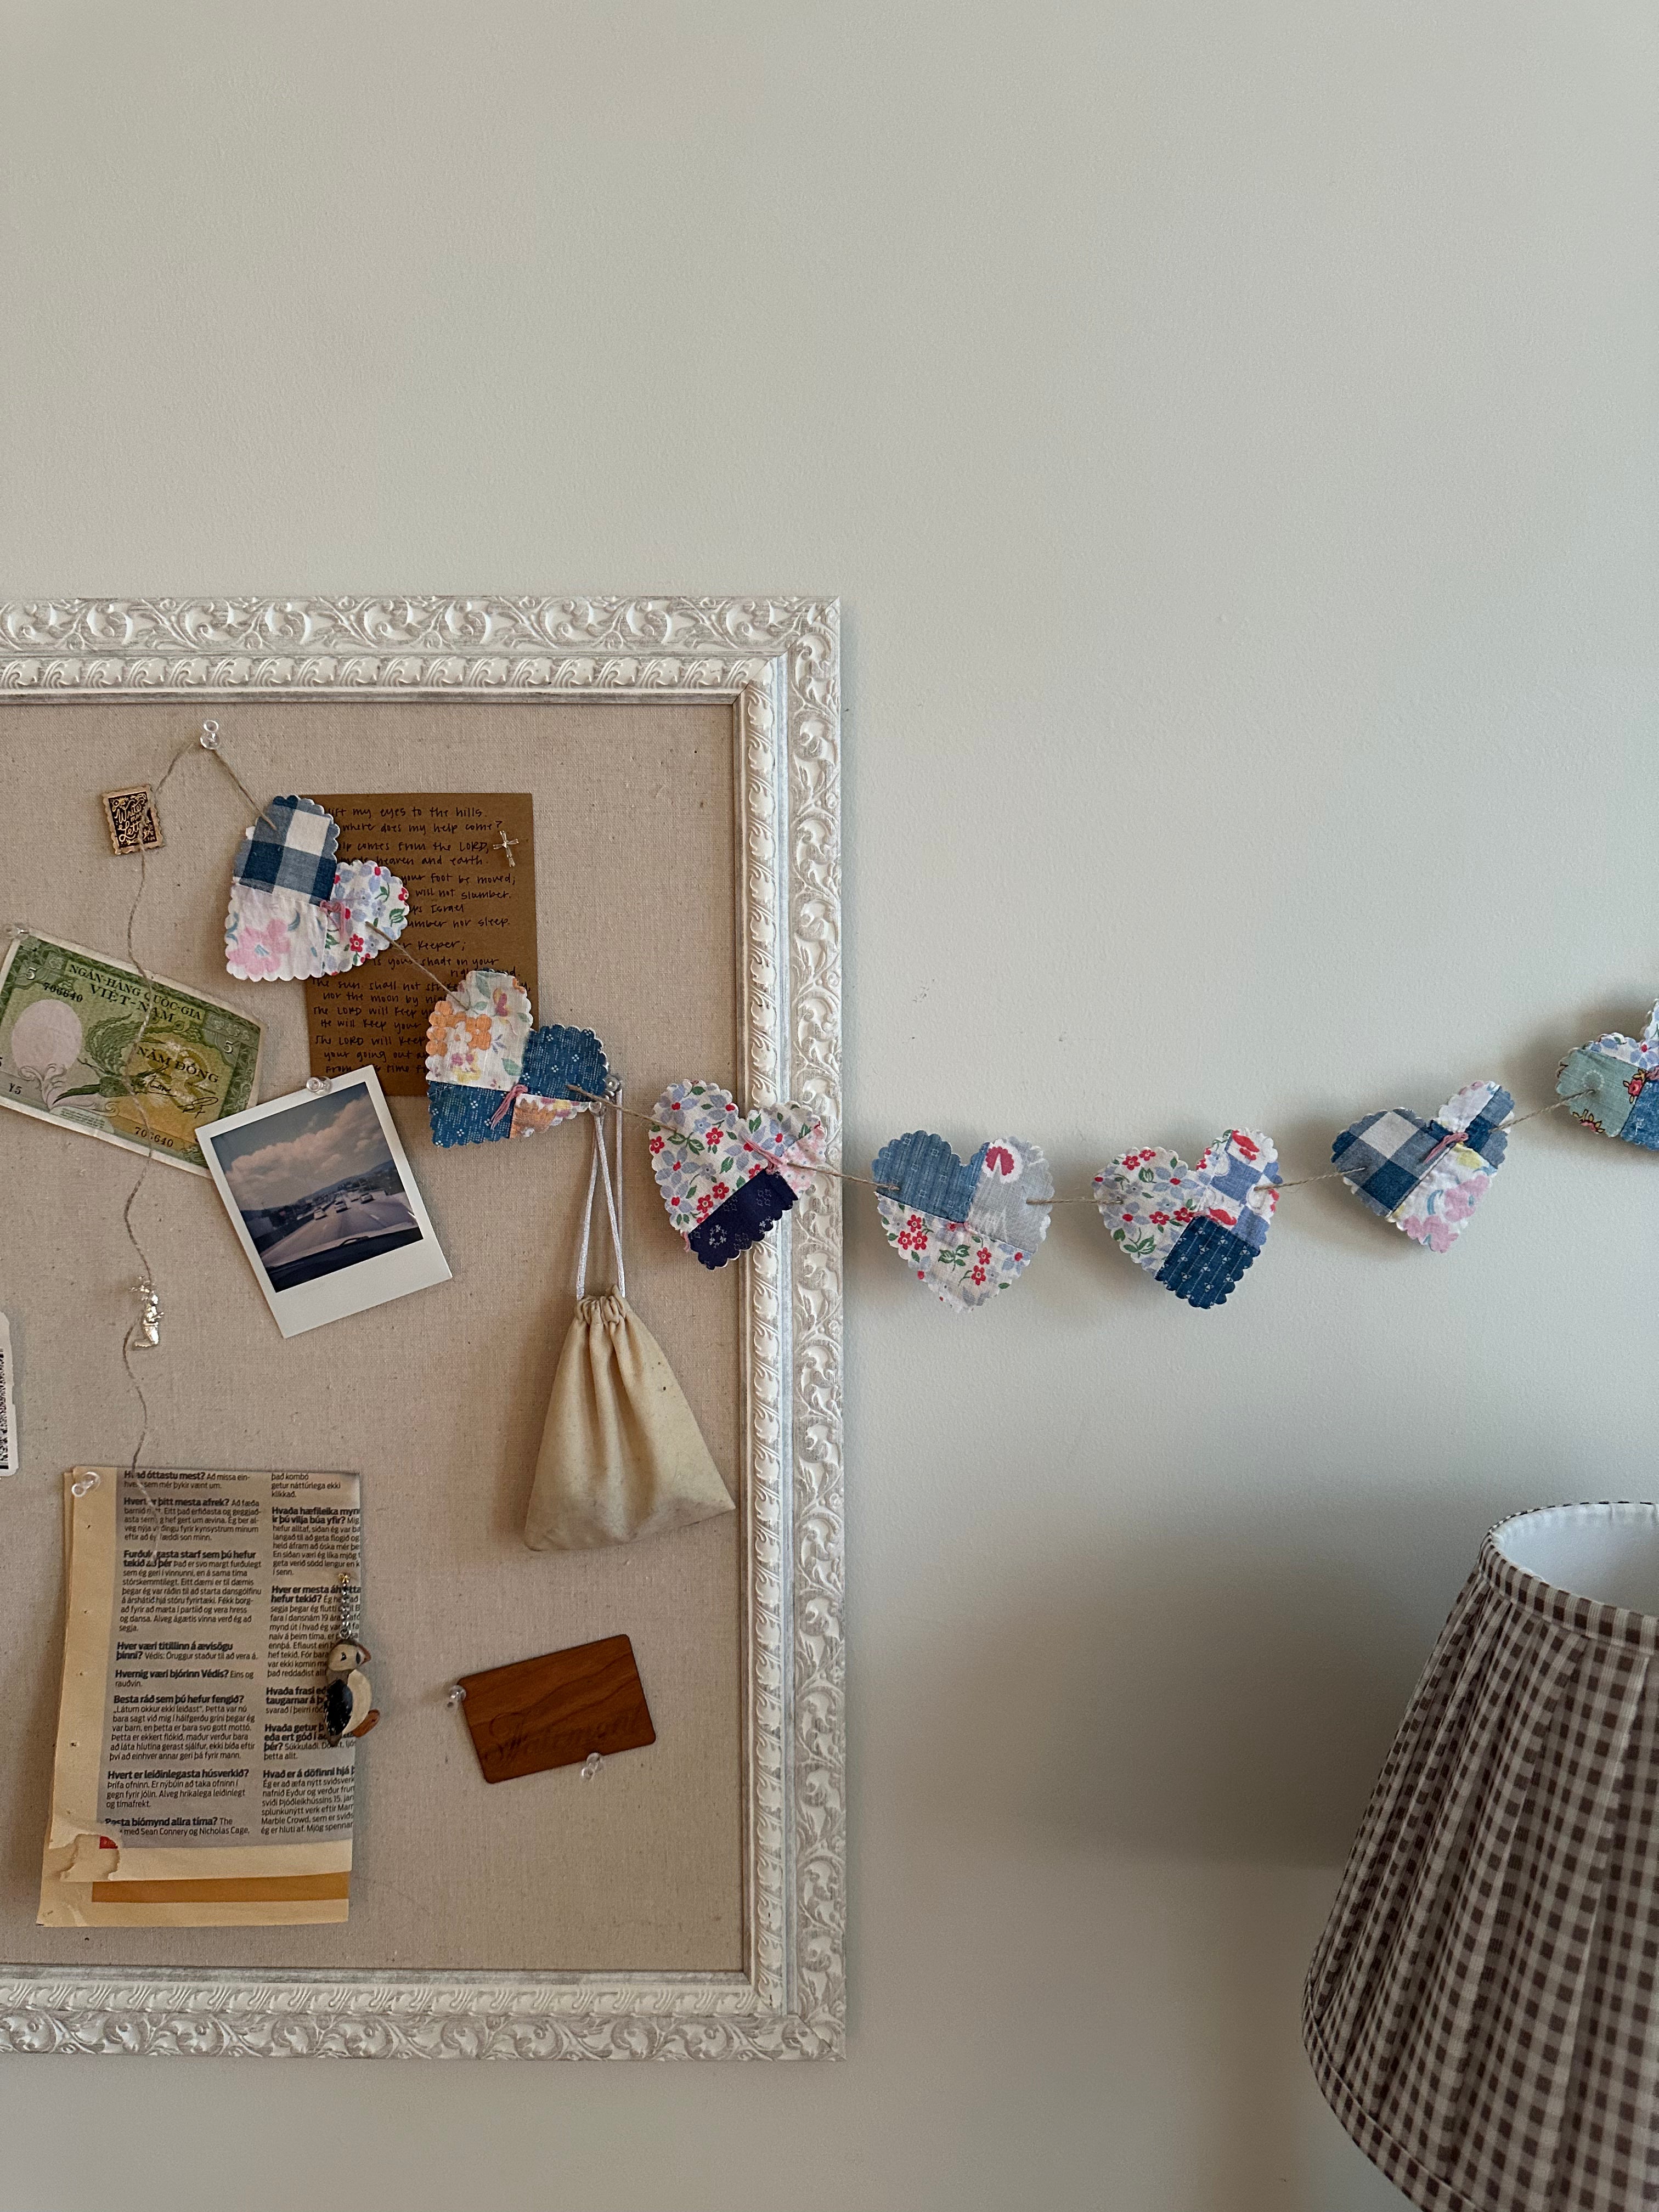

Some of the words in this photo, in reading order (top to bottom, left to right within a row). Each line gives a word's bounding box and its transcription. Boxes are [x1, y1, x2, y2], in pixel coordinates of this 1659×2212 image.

[353, 808, 371, 819] my
[380, 808, 405, 819] eyes
[412, 807, 422, 817] to
[430, 806, 448, 817] the
[456, 807, 487, 817] hills.
[381, 823, 401, 833] does
[409, 824, 426, 835] my
[434, 823, 458, 834] help
[358, 843, 390, 851] comes
[433, 842, 451, 851] the
[460, 842, 489, 854] LORD,
[376, 856, 414, 865] heaven
[422, 855, 442, 865] and
[450, 855, 489, 866] earth.
[431, 873, 453, 883] foot
[459, 875, 470, 884] be
[477, 873, 515, 885] moved;
[416, 888, 434, 896] will
[439, 888, 456, 897] not
[461, 890, 511, 900] slumber.
[431, 904, 464, 913] Israel
[408, 919, 447, 928] umber
[453, 919, 471, 928] nor
[478, 916, 510, 928] sleep.
[421, 956, 452, 966] shade
[457, 958, 467, 966] on
[472, 958, 499, 970] your
[26, 966, 37, 980] 5
[338, 981, 360, 990] sun
[369, 981, 396, 990] shall
[403, 982, 421, 991] not
[43, 981, 83, 1003] 706640
[323, 992, 341, 1000] nor
[346, 991, 363, 1001] the
[371, 994, 399, 1003] moon
[405, 995, 419, 1007] by
[313, 1006, 329, 1014] The
[337, 1006, 362, 1015] LORD
[369, 1006, 388, 1015] will
[320, 1018, 332, 1027] He
[338, 1018, 355, 1028] will
[394, 1022, 422, 1034] your
[315, 1035, 332, 1045] The
[338, 1035, 364, 1046] LORD
[371, 1035, 392, 1046] will
[223, 1040, 234, 1054] 5
[324, 1050, 350, 1061] your
[357, 1049, 387, 1063] going
[393, 1050, 413, 1059] out
[387, 1065, 410, 1074] time
[9, 1082, 22, 1095] Y5
[179, 1472, 205, 1480] mest?
[175, 1498, 201, 1506] mesta
[203, 1498, 229, 1506] afrek?
[180, 1550, 202, 1559] starf
[234, 1550, 256, 1559] hefur
[117, 1641, 137, 1650] Hver
[114, 1695, 139, 1703] Besta
[187, 1695, 210, 1703] hefur
[108, 1770, 133, 1779] Hvert
[219, 1817, 233, 1825] The
[261, 1816, 286, 1825] Marble
[140, 1827, 158, 1836] Sean
[159, 1827, 188, 1837] Connery
[189, 1828, 198, 1837] og
[199, 1826, 229, 1835] Nicholas
